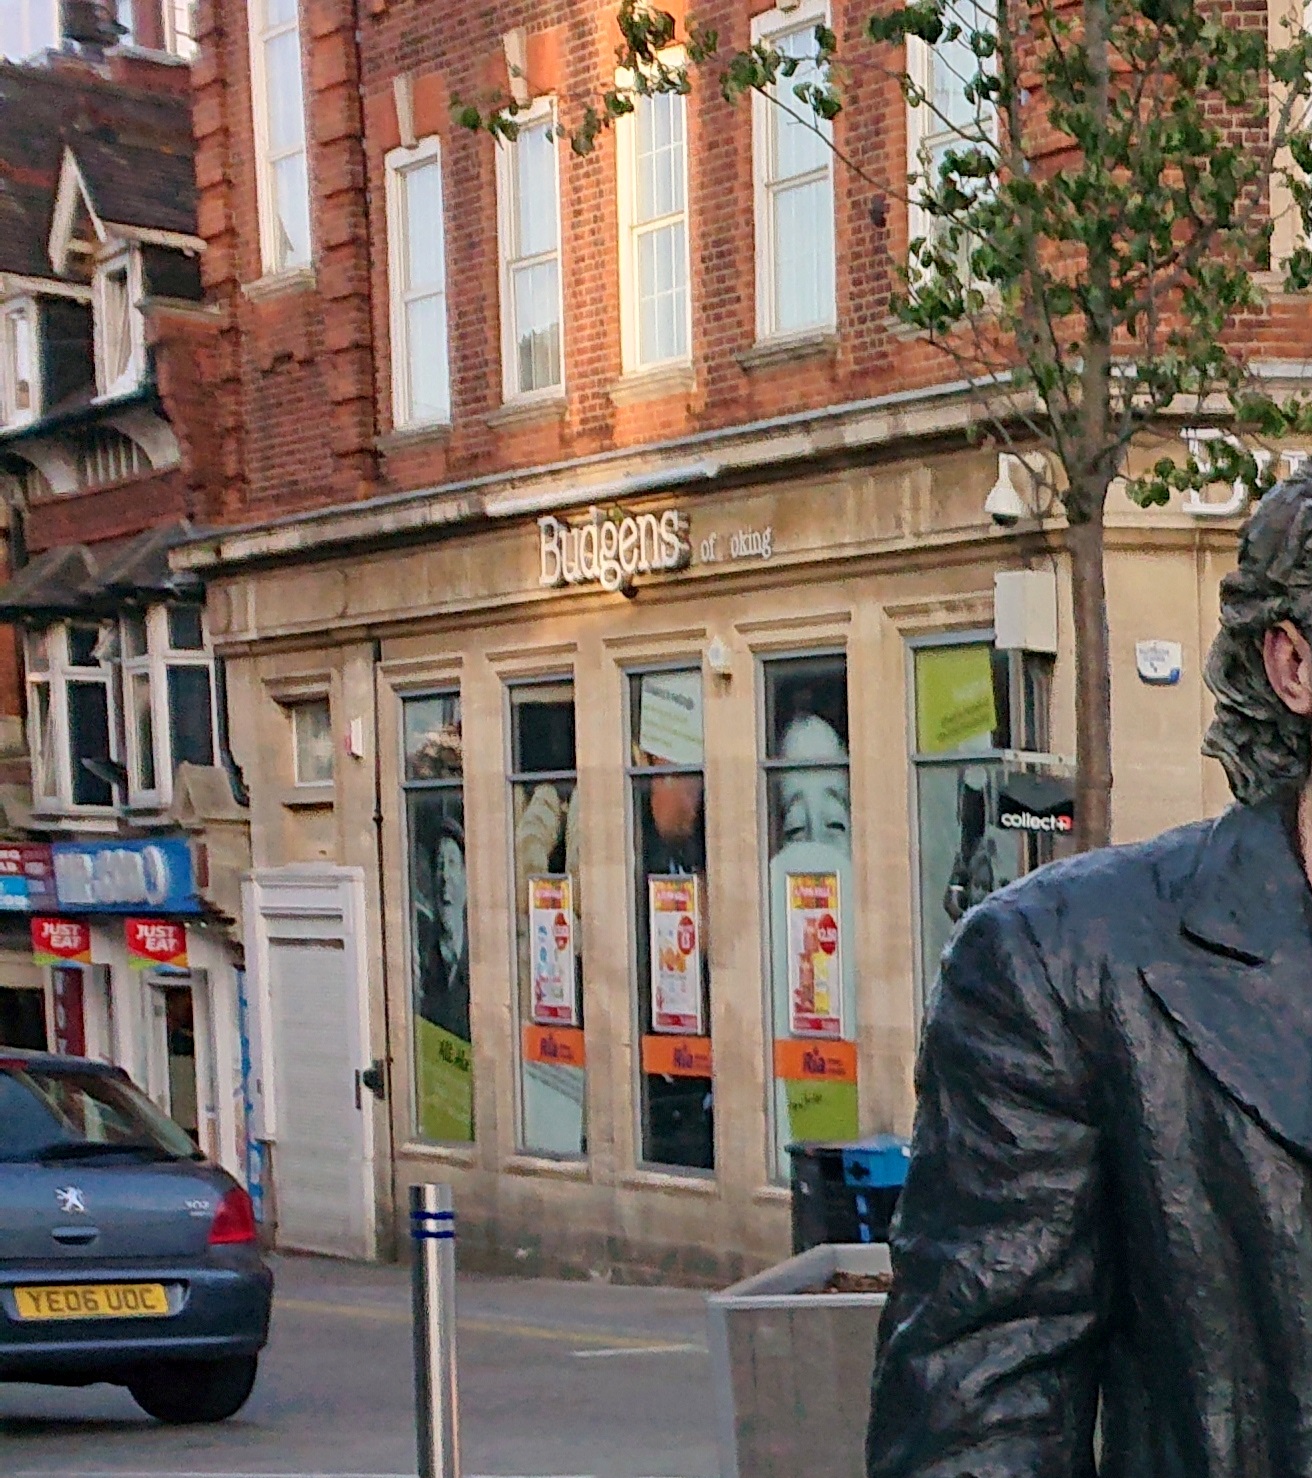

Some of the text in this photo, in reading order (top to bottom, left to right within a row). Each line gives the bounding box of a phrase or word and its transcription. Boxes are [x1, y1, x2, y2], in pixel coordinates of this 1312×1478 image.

[536, 505, 680, 592] Budgens
[701, 532, 718, 563] of
[41, 922, 82, 938] JUST
[136, 924, 178, 940] JUST
[50, 935, 82, 949] EAT
[145, 937, 178, 951] EAT
[25, 1287, 157, 1313] YE06 UOC
